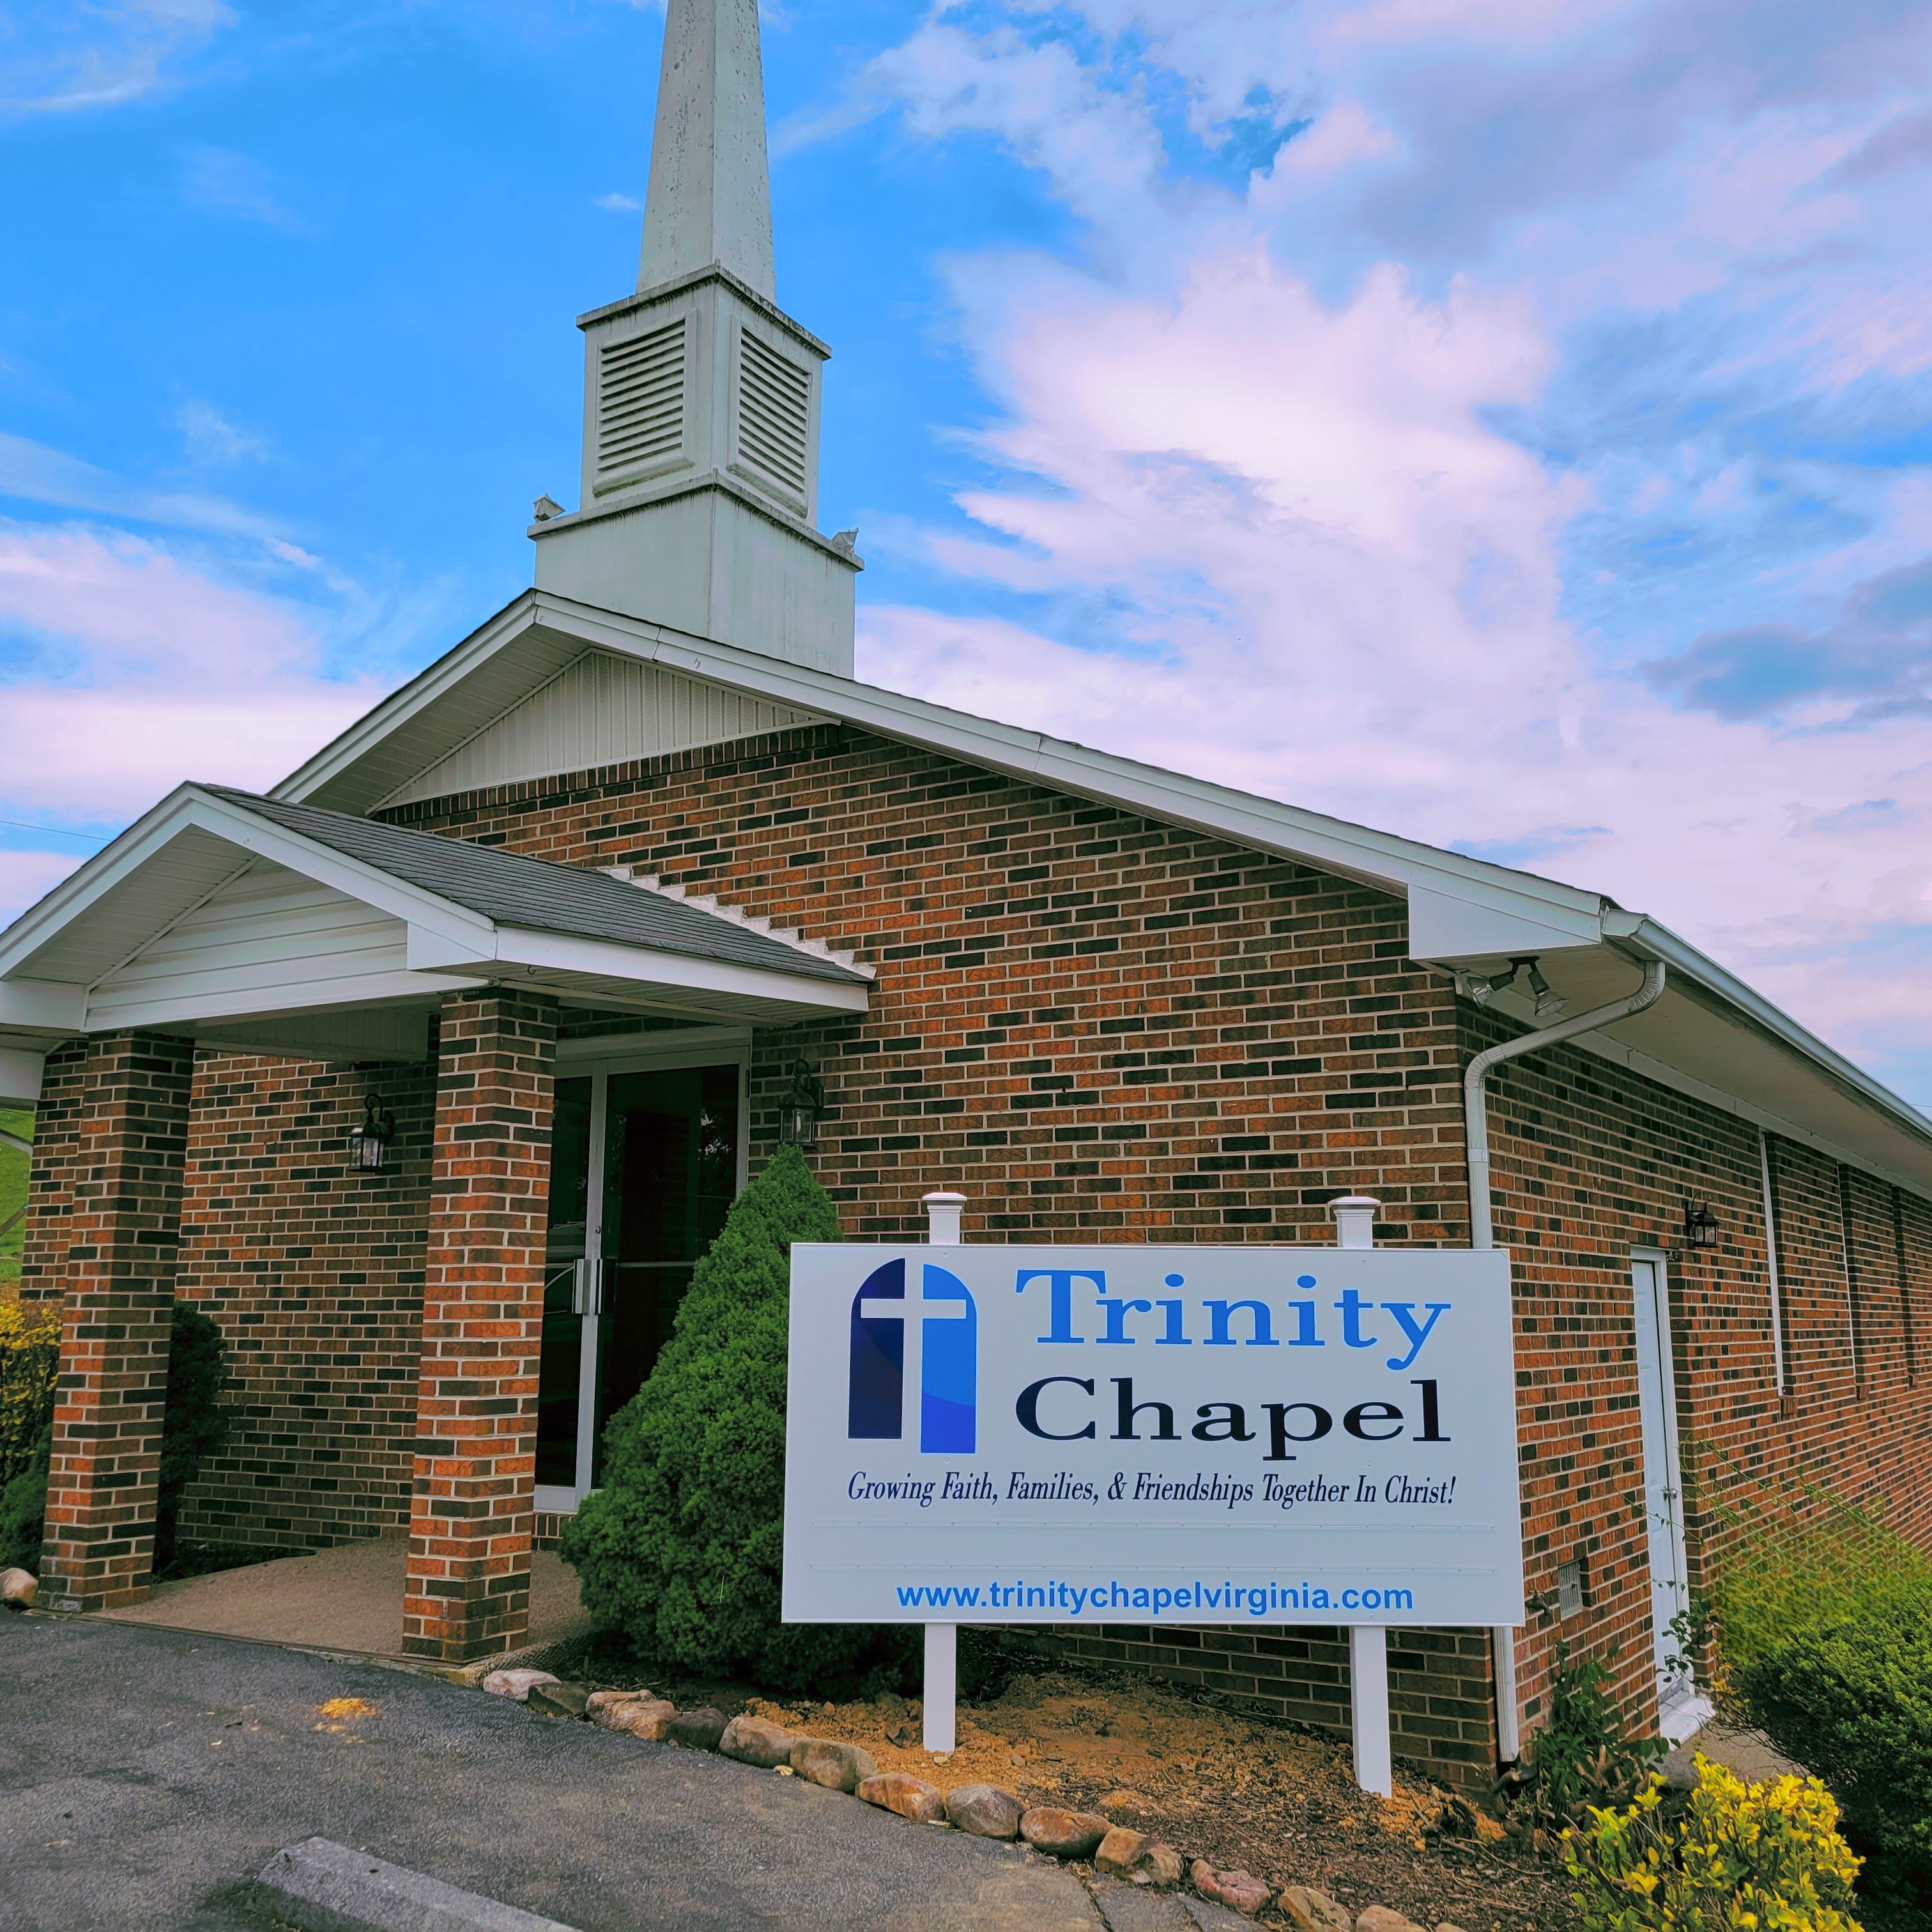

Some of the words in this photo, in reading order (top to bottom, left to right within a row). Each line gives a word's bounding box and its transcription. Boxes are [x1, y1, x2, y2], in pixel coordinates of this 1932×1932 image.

[1015, 1269, 1452, 1371] Trinity
[1015, 1376, 1452, 1461] Chapel
[848, 1471, 936, 1508] Growing
[940, 1471, 998, 1506] Faith,
[1005, 1471, 1099, 1506] Families,
[1107, 1471, 1128, 1501] &
[1131, 1472, 1254, 1510] Friendships
[1262, 1473, 1351, 1510] Together
[1353, 1475, 1377, 1503] In
[1384, 1475, 1457, 1505] Christ!
[896, 1580, 1413, 1616] www.trinitychapelvirginia.com
